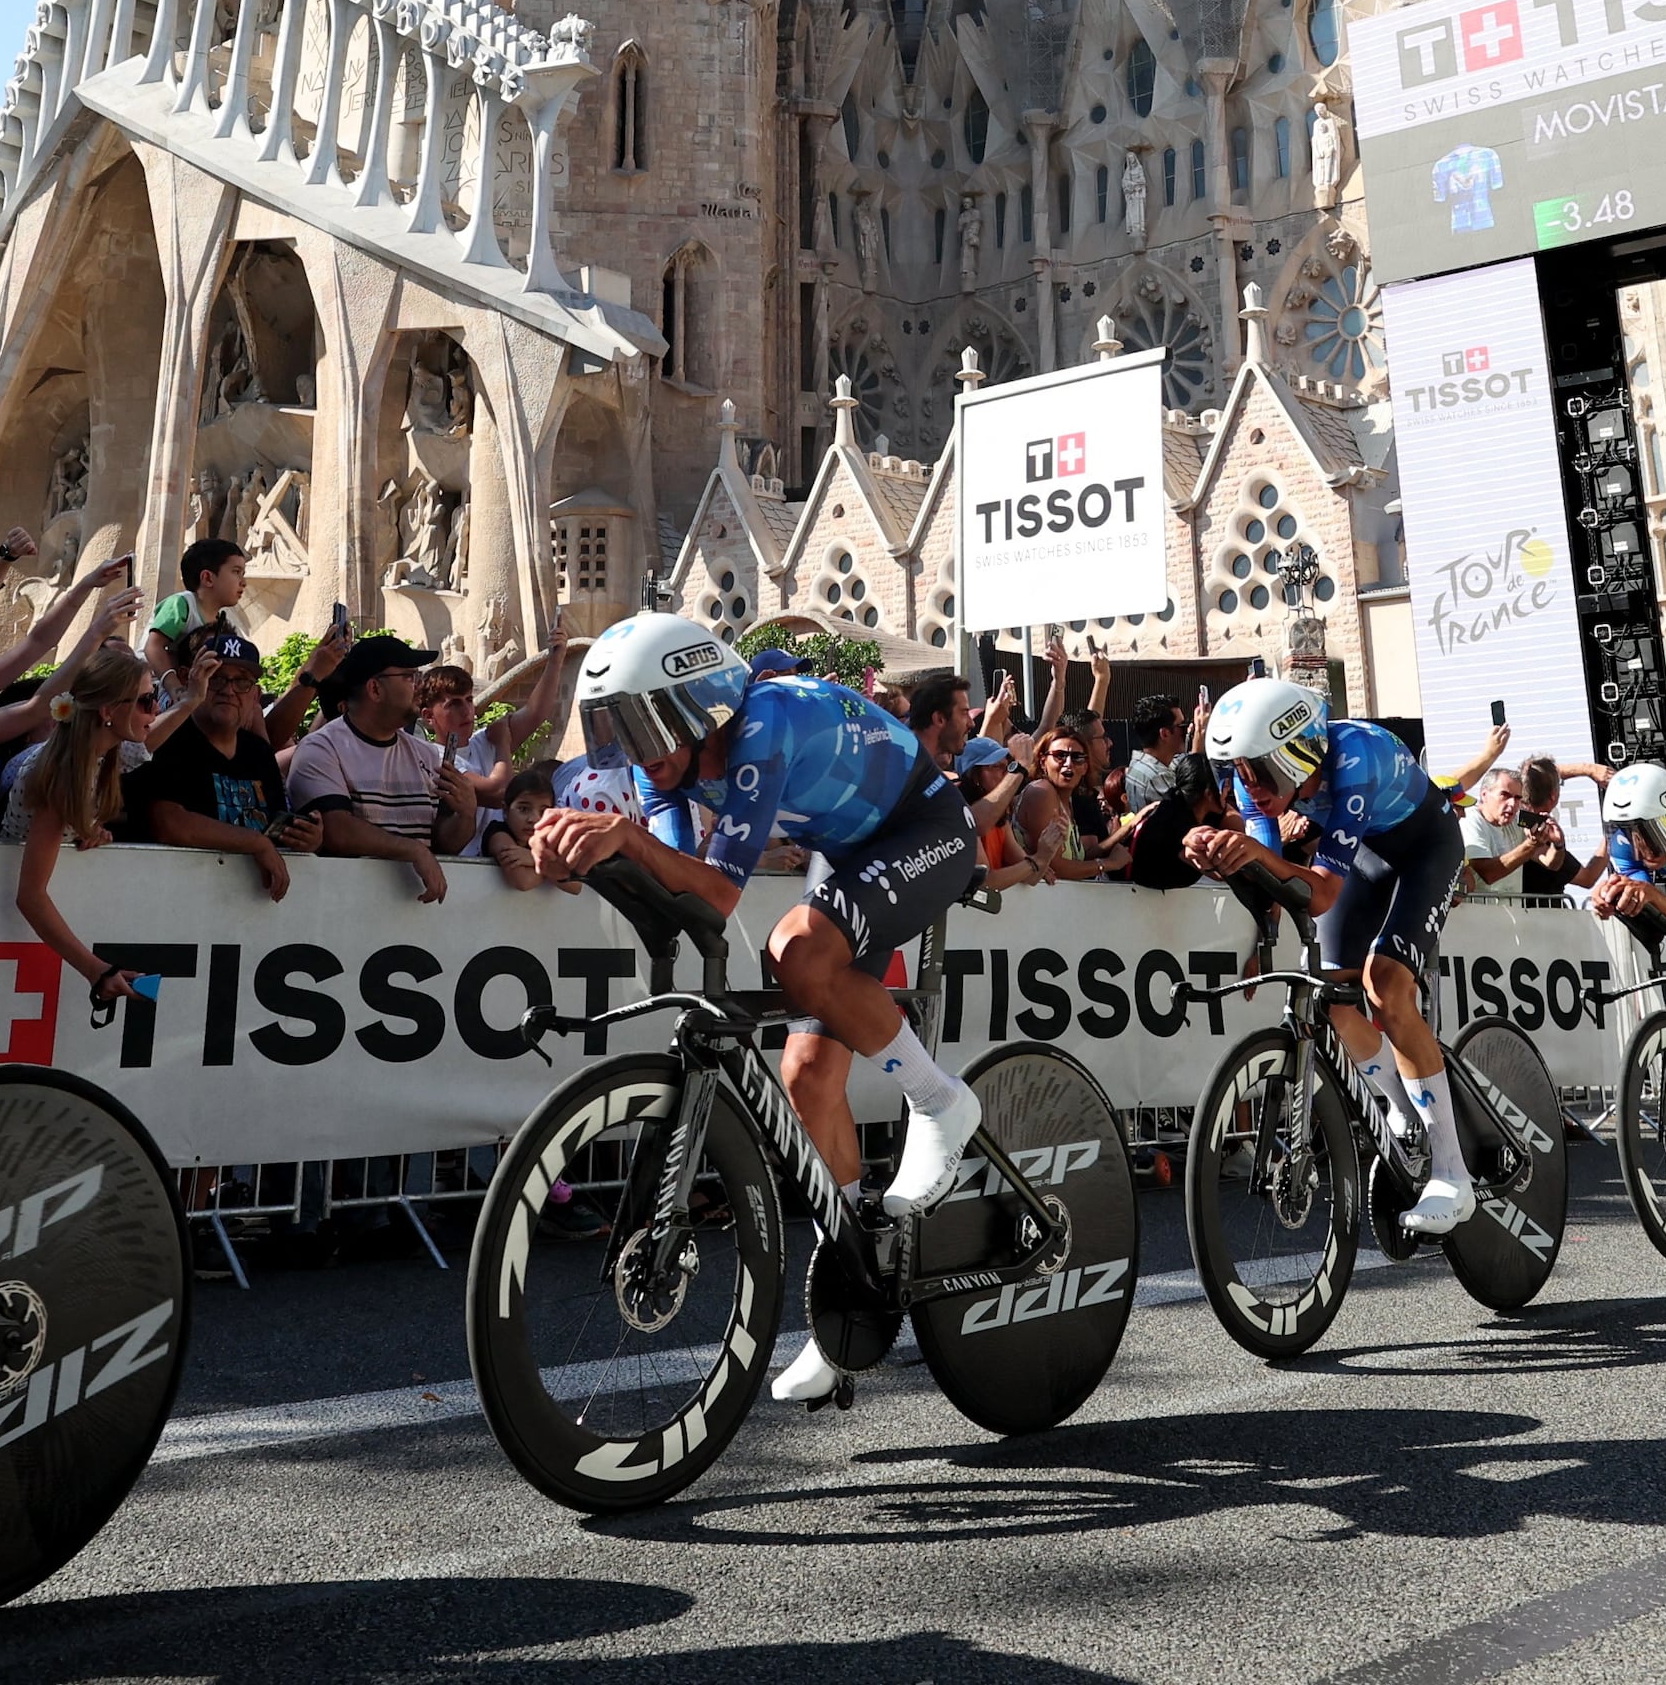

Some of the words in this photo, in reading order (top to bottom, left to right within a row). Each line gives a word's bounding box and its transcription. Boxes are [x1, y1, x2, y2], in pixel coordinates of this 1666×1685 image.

[1404, 80, 1503, 121] SWISS
[1545, 190, 1634, 233] -3.48
[1405, 368, 1533, 412] TISSOT
[975, 475, 1145, 544] TISSOT
[975, 550, 1010, 569] SWISS
[1014, 543, 1071, 562] WATCHES
[1074, 537, 1114, 554] SINCE
[1118, 532, 1149, 548] 1853
[1435, 526, 1538, 603] TOUR
[1507, 573, 1525, 593] de
[673, 645, 719, 673] ABUS
[1276, 705, 1309, 736] ABUS
[892, 835, 967, 884] Telefónica
[92, 942, 637, 1068] TISSOT
[941, 947, 1238, 1044] TISSOT
[741, 1047, 843, 1243] CANYON
[651, 1123, 689, 1242] CANYON
[942, 1271, 1003, 1293] CANYON
[961, 1257, 1130, 1336] ZIPP
